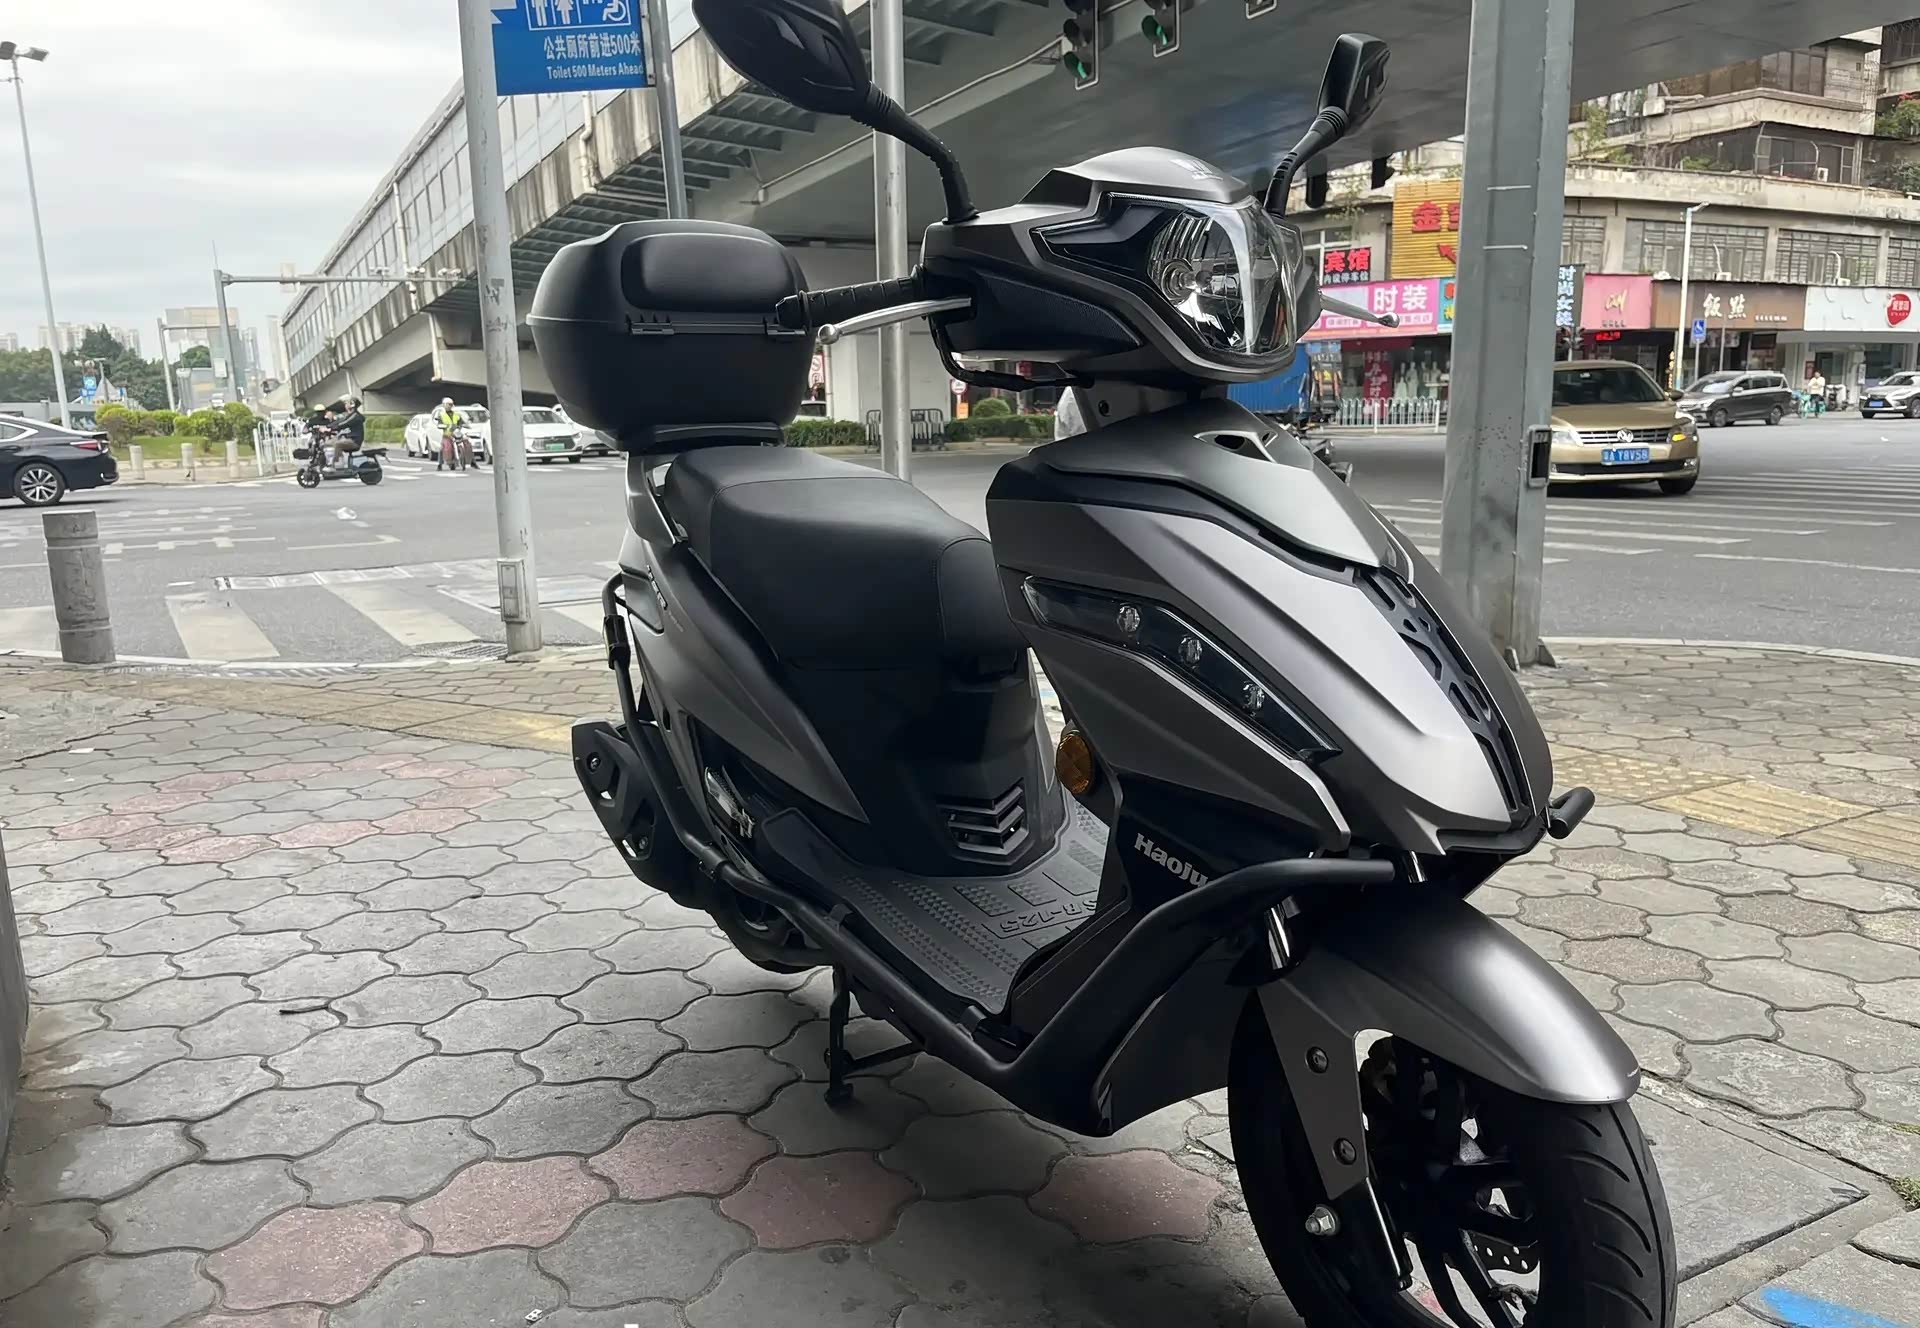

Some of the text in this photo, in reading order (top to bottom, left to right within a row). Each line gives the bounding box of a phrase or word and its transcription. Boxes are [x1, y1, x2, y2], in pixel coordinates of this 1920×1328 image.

[544, 31, 641, 60] 公共厕所前进500米
[547, 62, 644, 80] Toilet 500 Meters Ahead
[1325, 249, 1370, 273] 宾馆
[1373, 284, 1428, 312] 时装
[1556, 265, 1576, 328] 时尚女装
